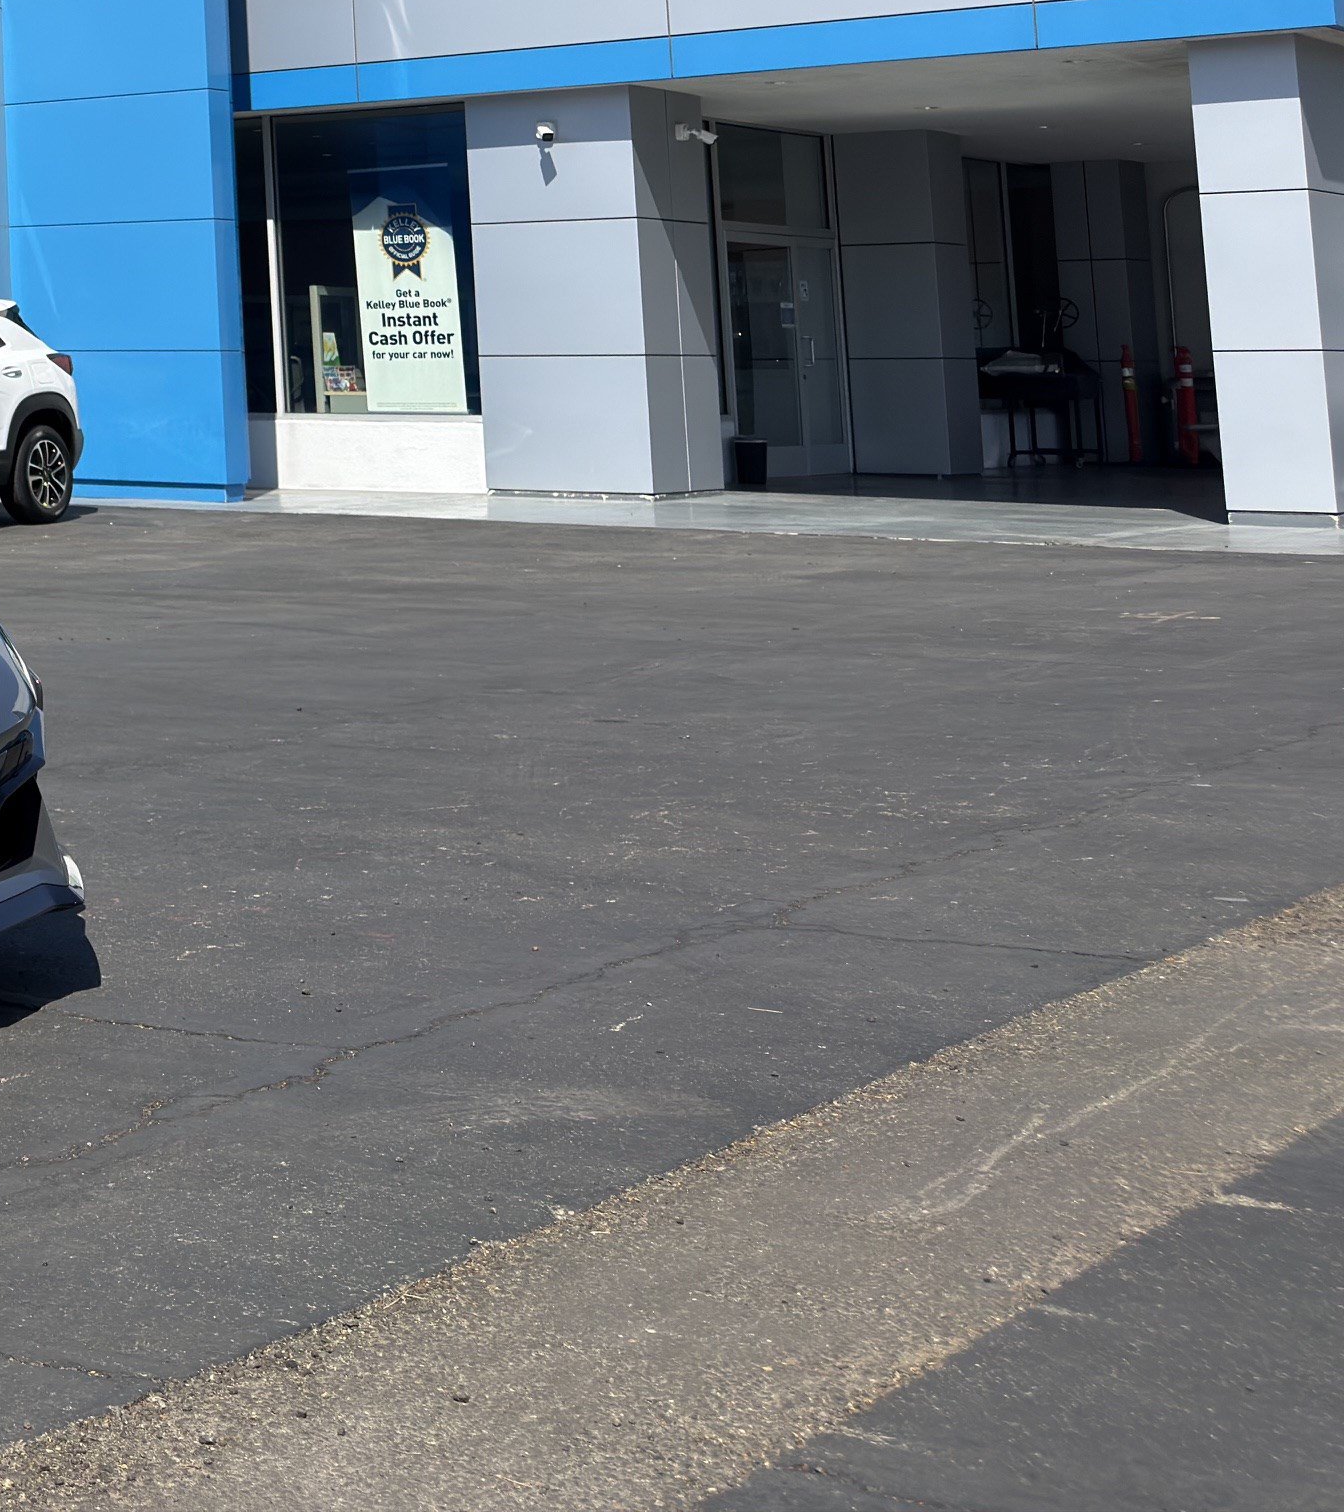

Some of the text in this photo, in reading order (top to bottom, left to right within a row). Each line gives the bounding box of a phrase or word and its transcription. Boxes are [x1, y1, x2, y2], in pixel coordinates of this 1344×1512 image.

[387, 217, 421, 233] KELLEY
[383, 233, 425, 245] BLUE BOOK
[395, 288, 413, 299] Get
[366, 300, 396, 310] Kelley
[398, 299, 421, 309] Blue
[381, 312, 439, 328] Instant
[368, 330, 455, 346] Cash Offer
[372, 349, 455, 361] for your car now!
